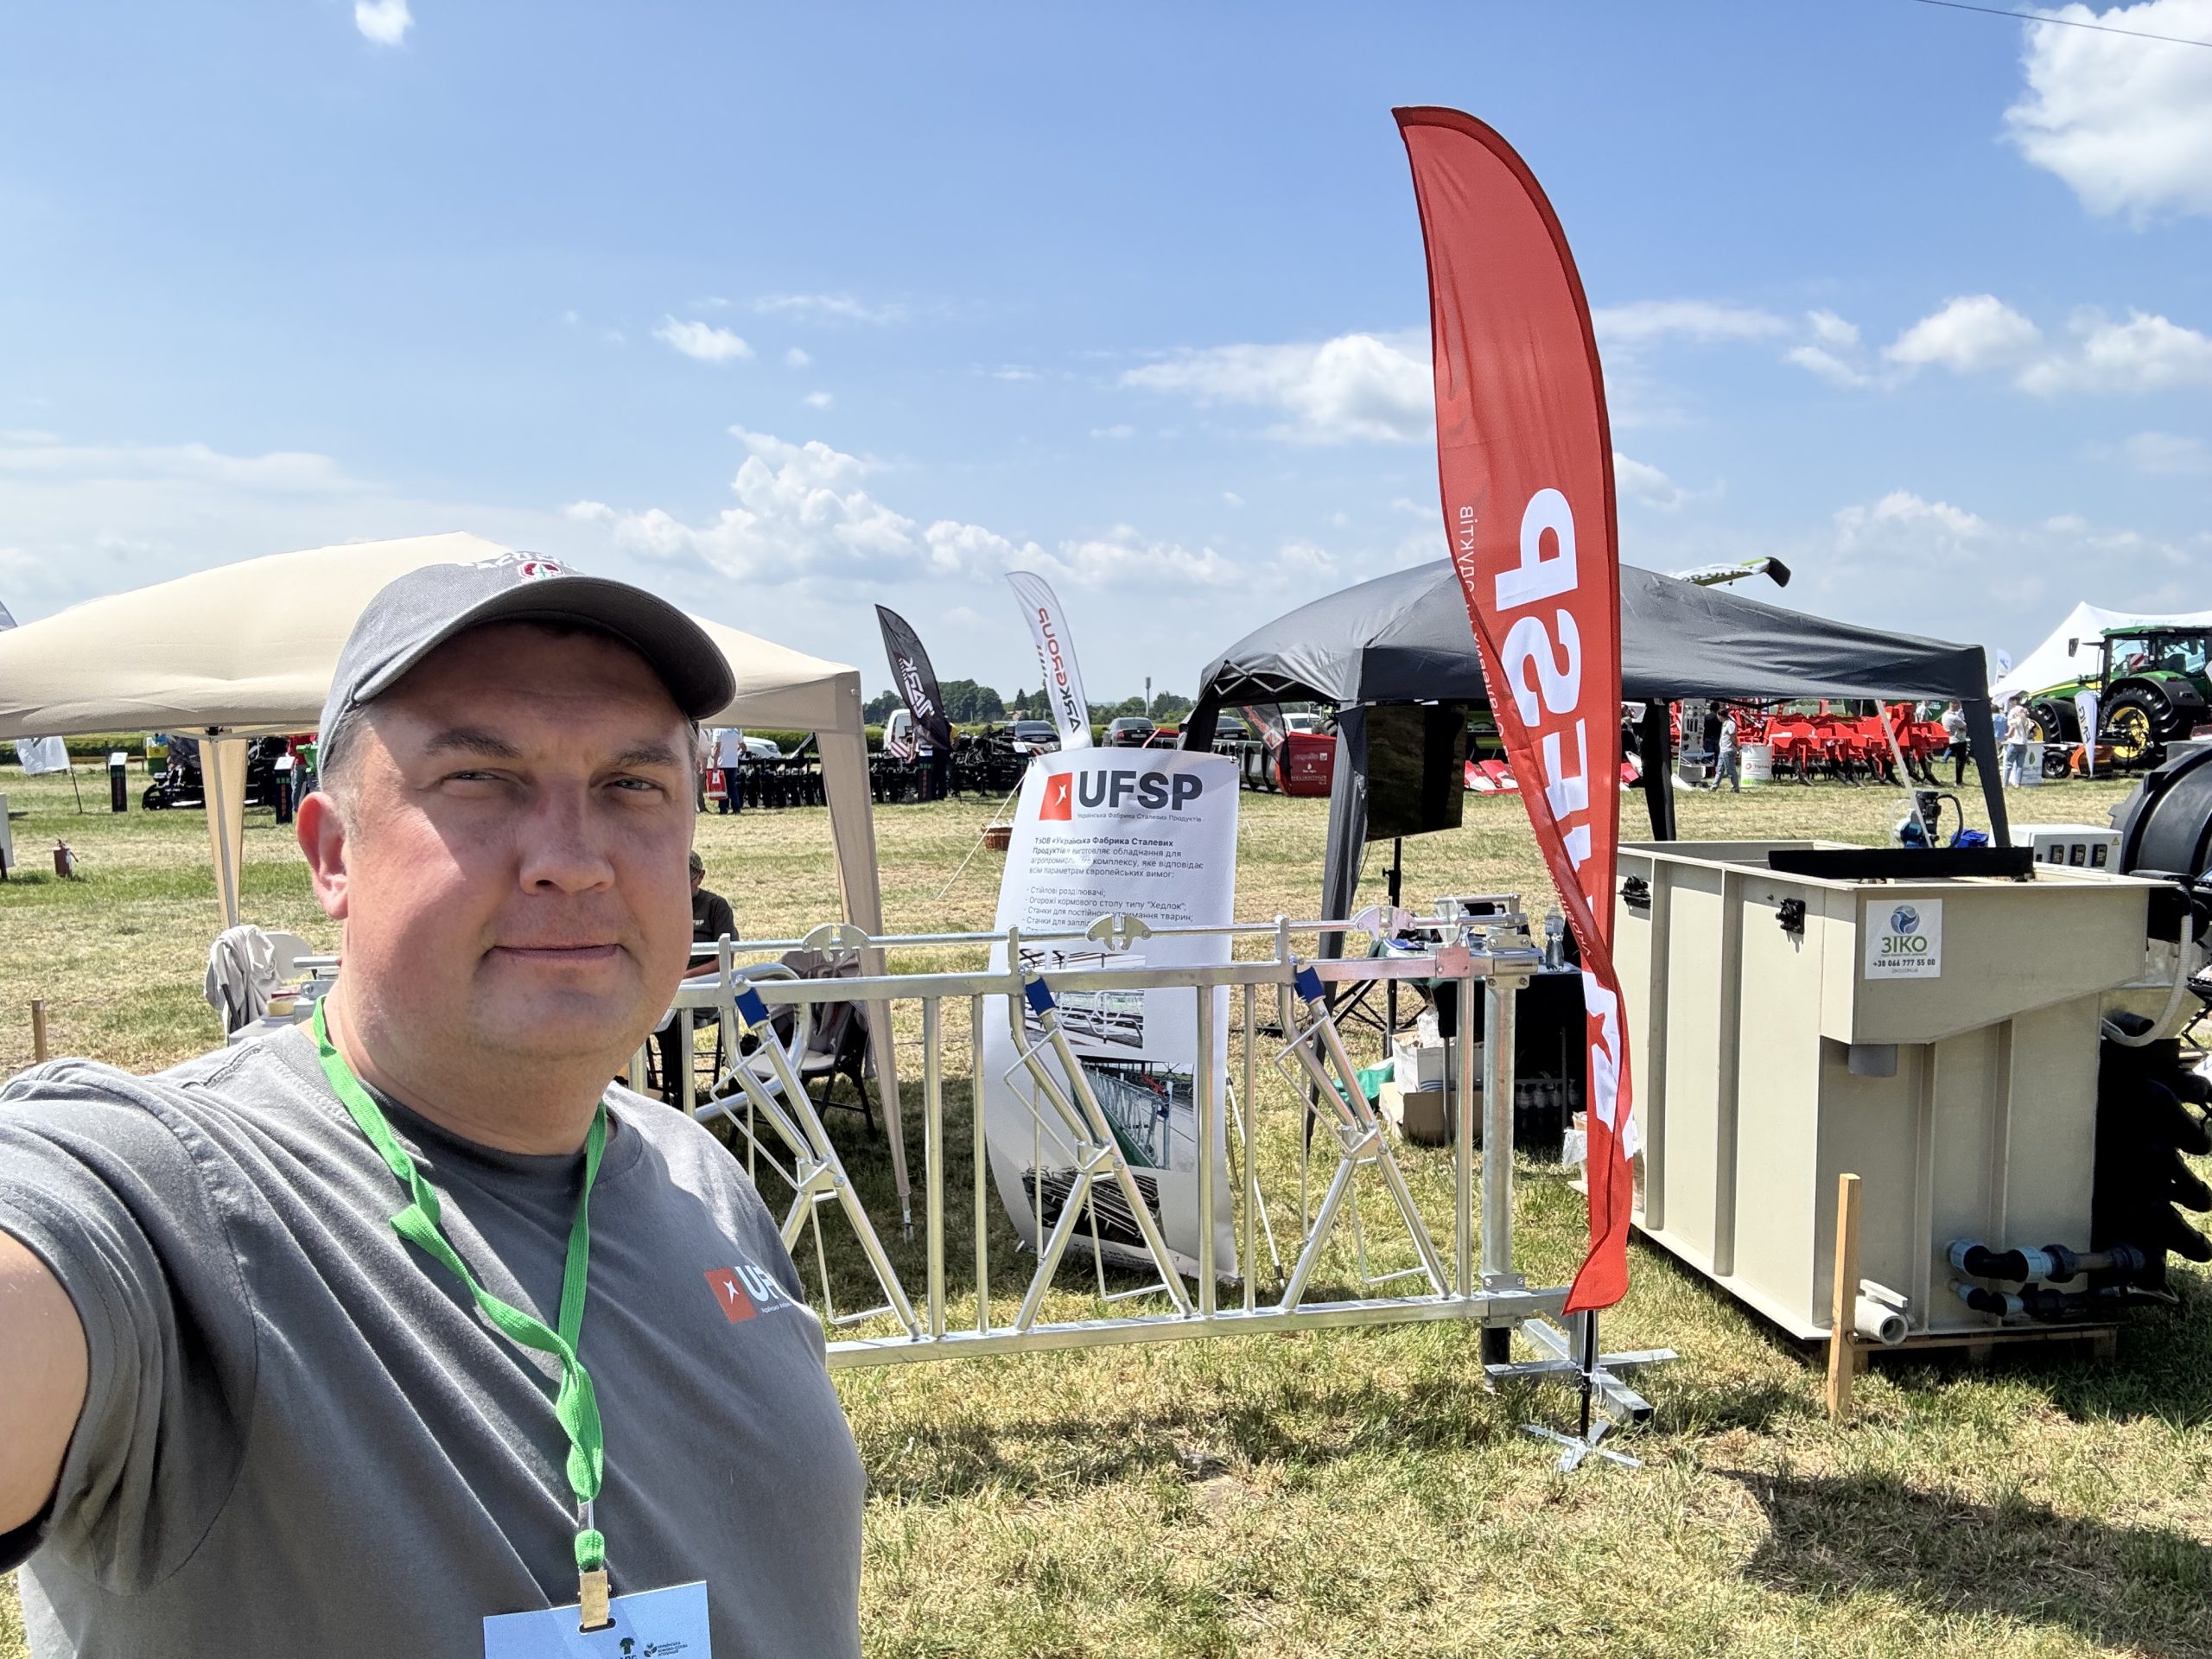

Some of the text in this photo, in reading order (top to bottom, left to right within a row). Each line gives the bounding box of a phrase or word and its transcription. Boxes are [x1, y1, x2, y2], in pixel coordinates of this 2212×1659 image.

[1079, 771, 1203, 810] UFSP
[1092, 836, 1129, 846] Фабрика
[1131, 837, 1173, 847] Сталевих
[1113, 848, 1164, 857] обладнання
[1159, 861, 1204, 869] відповідає
[1029, 896, 1057, 905] Огорожі
[1099, 900, 1123, 909] столу
[1126, 900, 1145, 910] типу
[1027, 916, 1051, 925] Станки
[1160, 913, 1193, 922] тварин;
